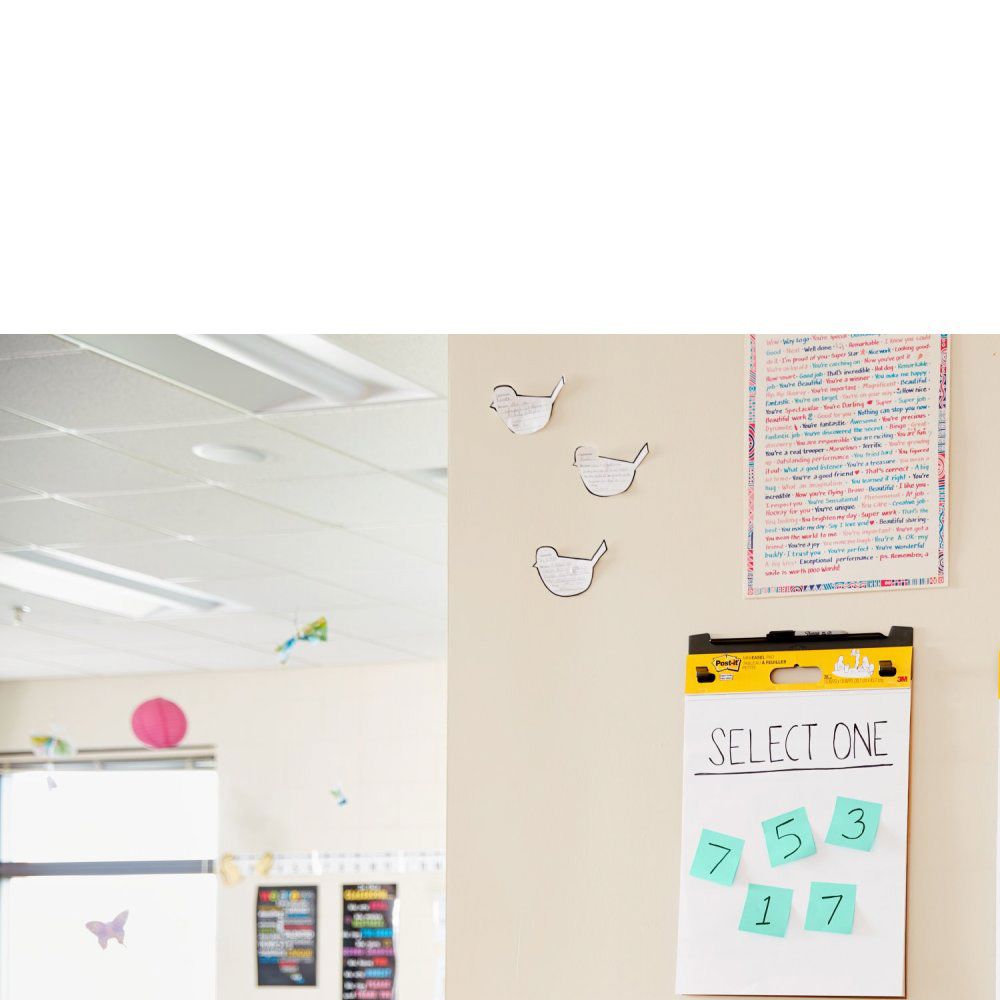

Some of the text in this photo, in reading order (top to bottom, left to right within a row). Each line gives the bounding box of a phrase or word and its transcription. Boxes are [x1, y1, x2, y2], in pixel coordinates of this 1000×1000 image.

[844, 367, 870, 376] incredible
[818, 472, 833, 480] good
[800, 555, 874, 565] Exceptional performance
[811, 542, 820, 550] joy
[894, 542, 925, 550] wonderful
[708, 720, 888, 766] SELECT ONE
[775, 818, 802, 859] 5
[842, 808, 866, 840] 3
[708, 842, 732, 875] 7
[755, 896, 771, 926] 1
[821, 894, 844, 925] 7
